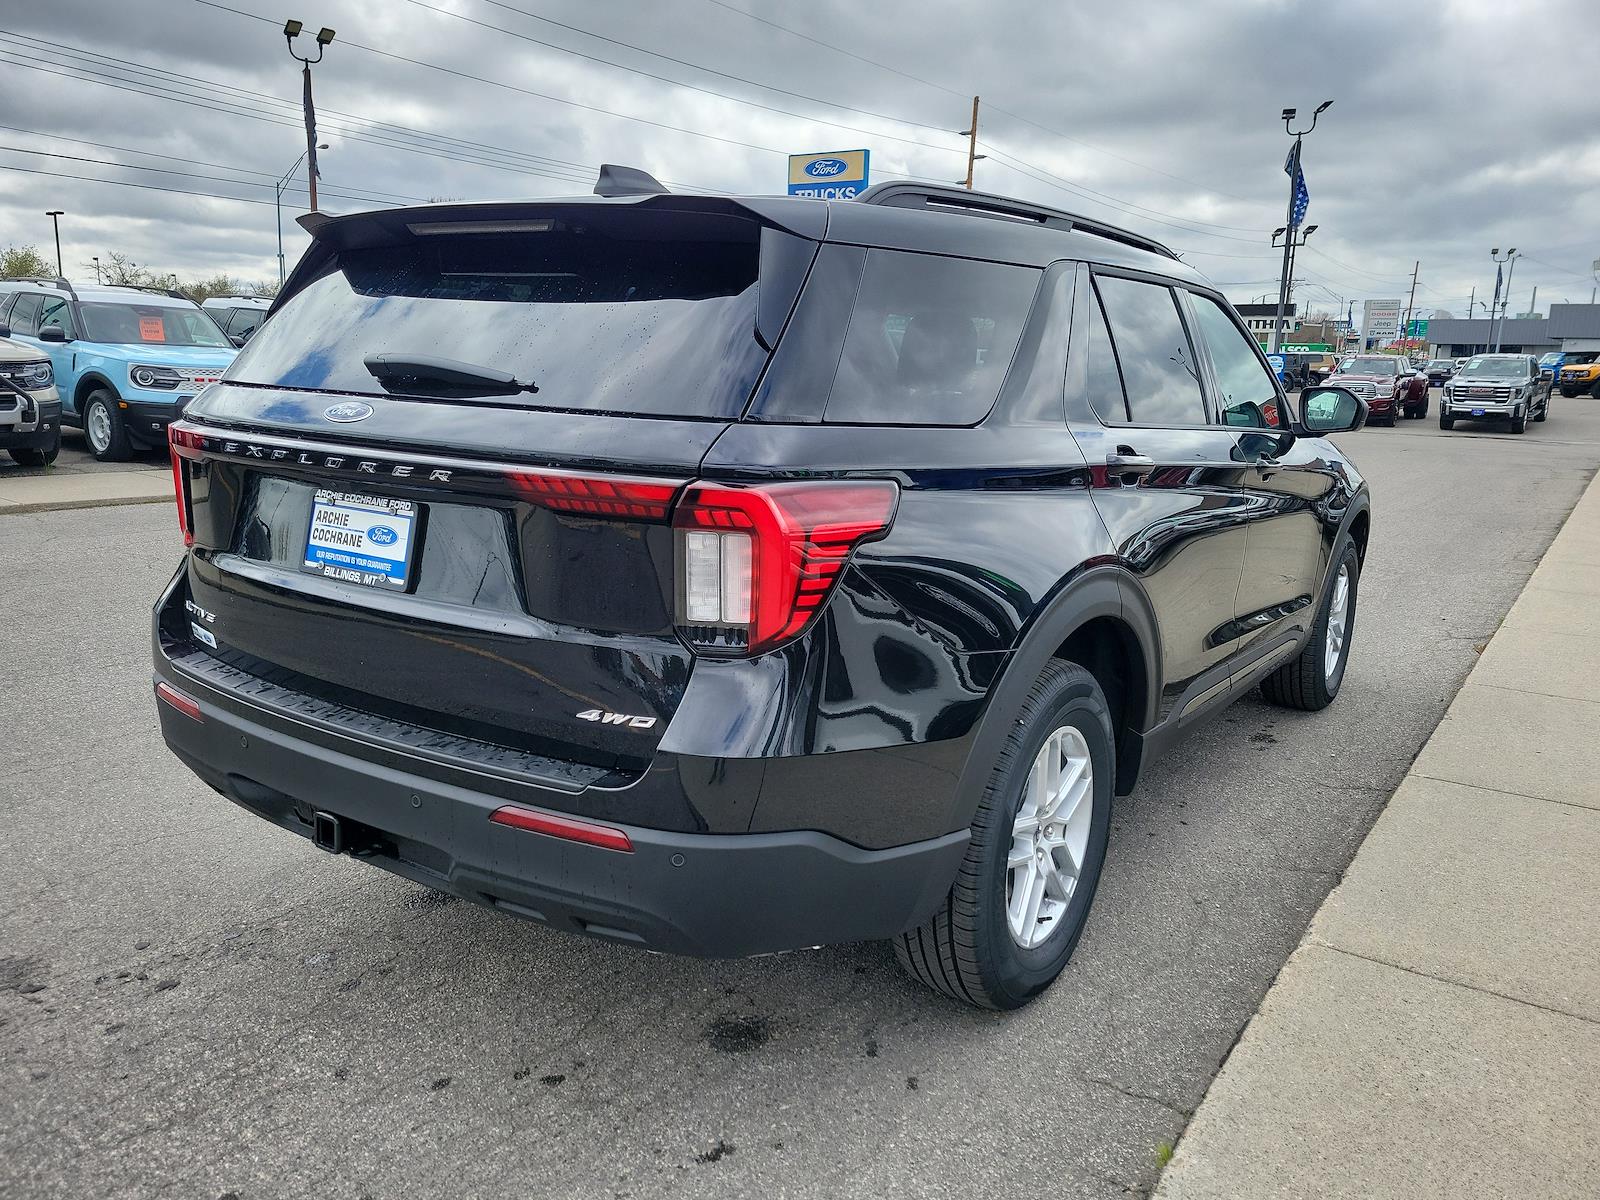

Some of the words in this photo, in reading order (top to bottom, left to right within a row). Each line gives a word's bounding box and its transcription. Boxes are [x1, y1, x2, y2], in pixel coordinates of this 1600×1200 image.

[812, 161, 840, 175] Ford
[1247, 319, 1291, 329] ITHIA
[223, 442, 453, 482] EXPLORER
[315, 489, 343, 500] ARCHIE
[344, 493, 388, 507] COCHRANE
[389, 500, 411, 511] FORD
[316, 510, 350, 527] ARCHIE
[312, 527, 363, 548] COCHRANE
[316, 550, 326, 559] OUR
[325, 551, 350, 564] REPUTATION
[356, 557, 367, 567] YOUR
[367, 559, 392, 572] GUARANTEE
[324, 566, 361, 584] BILLINGS,
[363, 574, 378, 586] MT
[185, 599, 216, 623] CTIVE
[576, 709, 657, 728] 4WD
